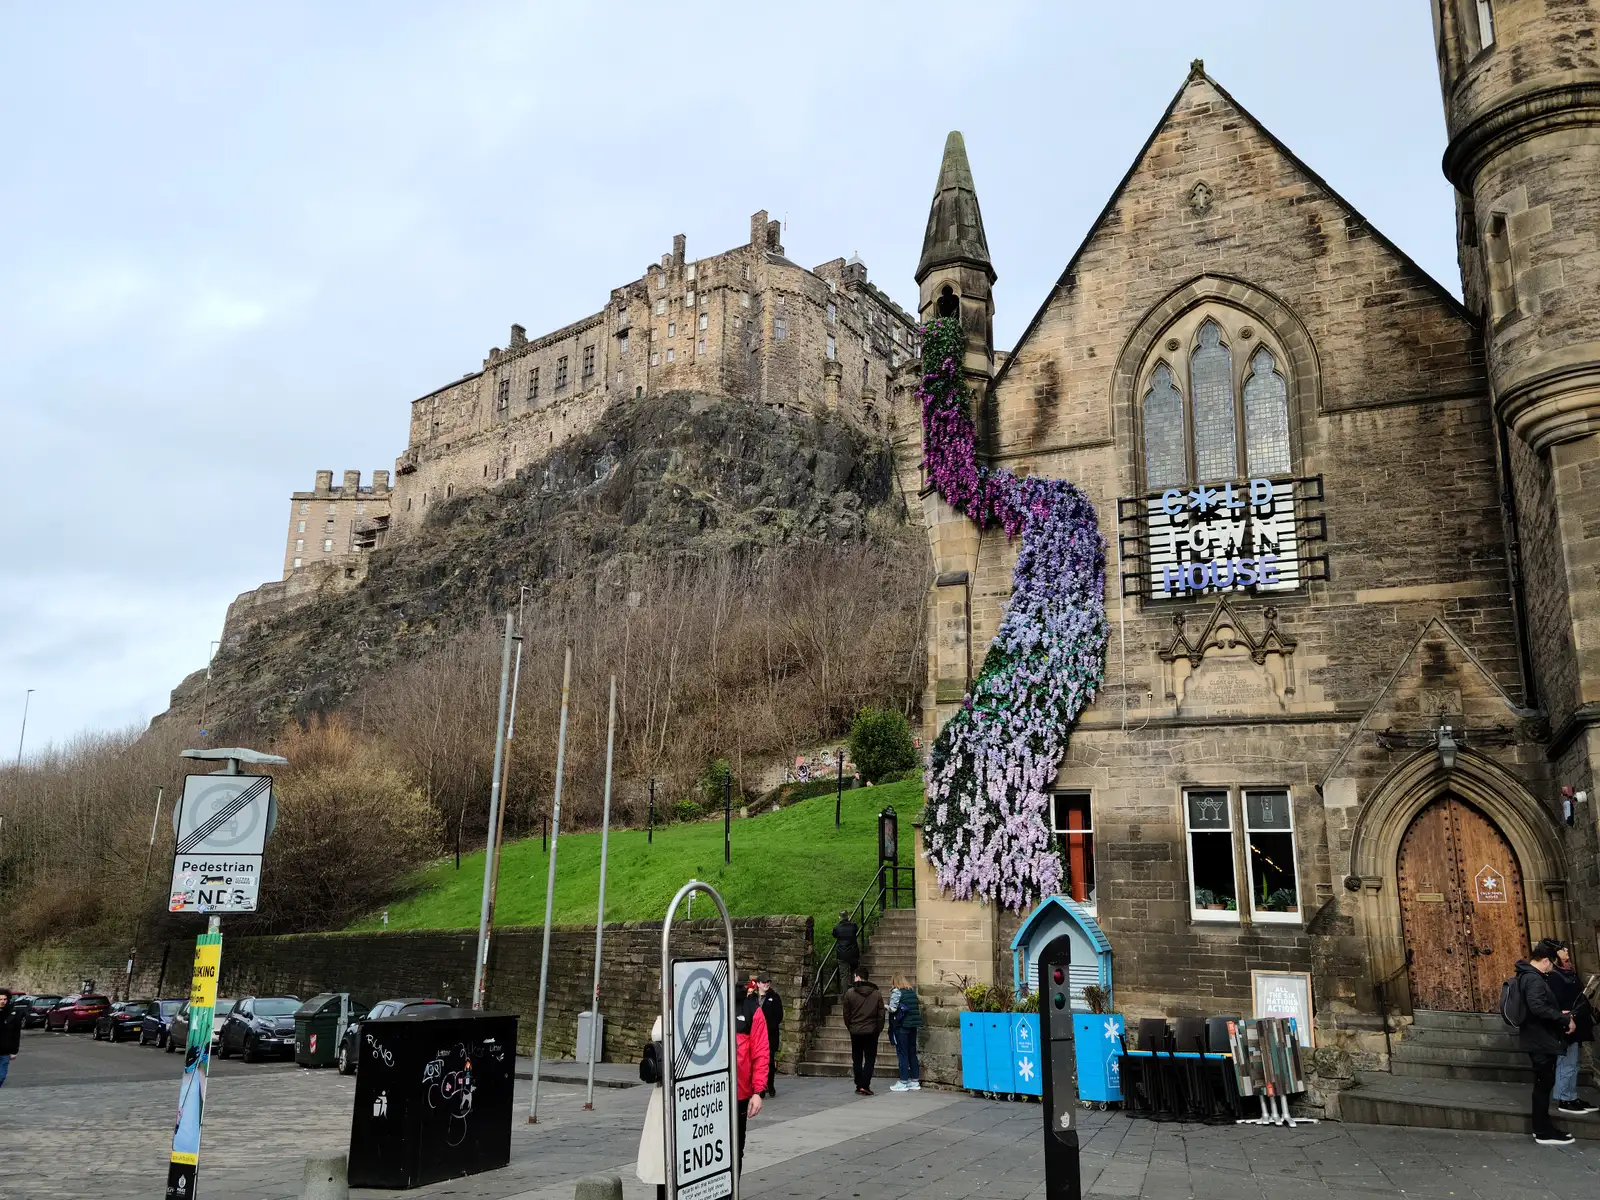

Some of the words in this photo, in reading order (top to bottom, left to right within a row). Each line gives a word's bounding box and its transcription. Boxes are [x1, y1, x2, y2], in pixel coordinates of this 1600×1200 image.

[1168, 517, 1279, 554] TOWN
[1163, 555, 1279, 593] HOUSE
[182, 861, 254, 872] Pedestrian
[200, 875, 233, 885] Ze
[678, 1080, 726, 1102] Pedestrian
[682, 1102, 699, 1122] and
[700, 1098, 723, 1118] cycle
[692, 1122, 714, 1140] Zone
[683, 1139, 724, 1175] ENDS
